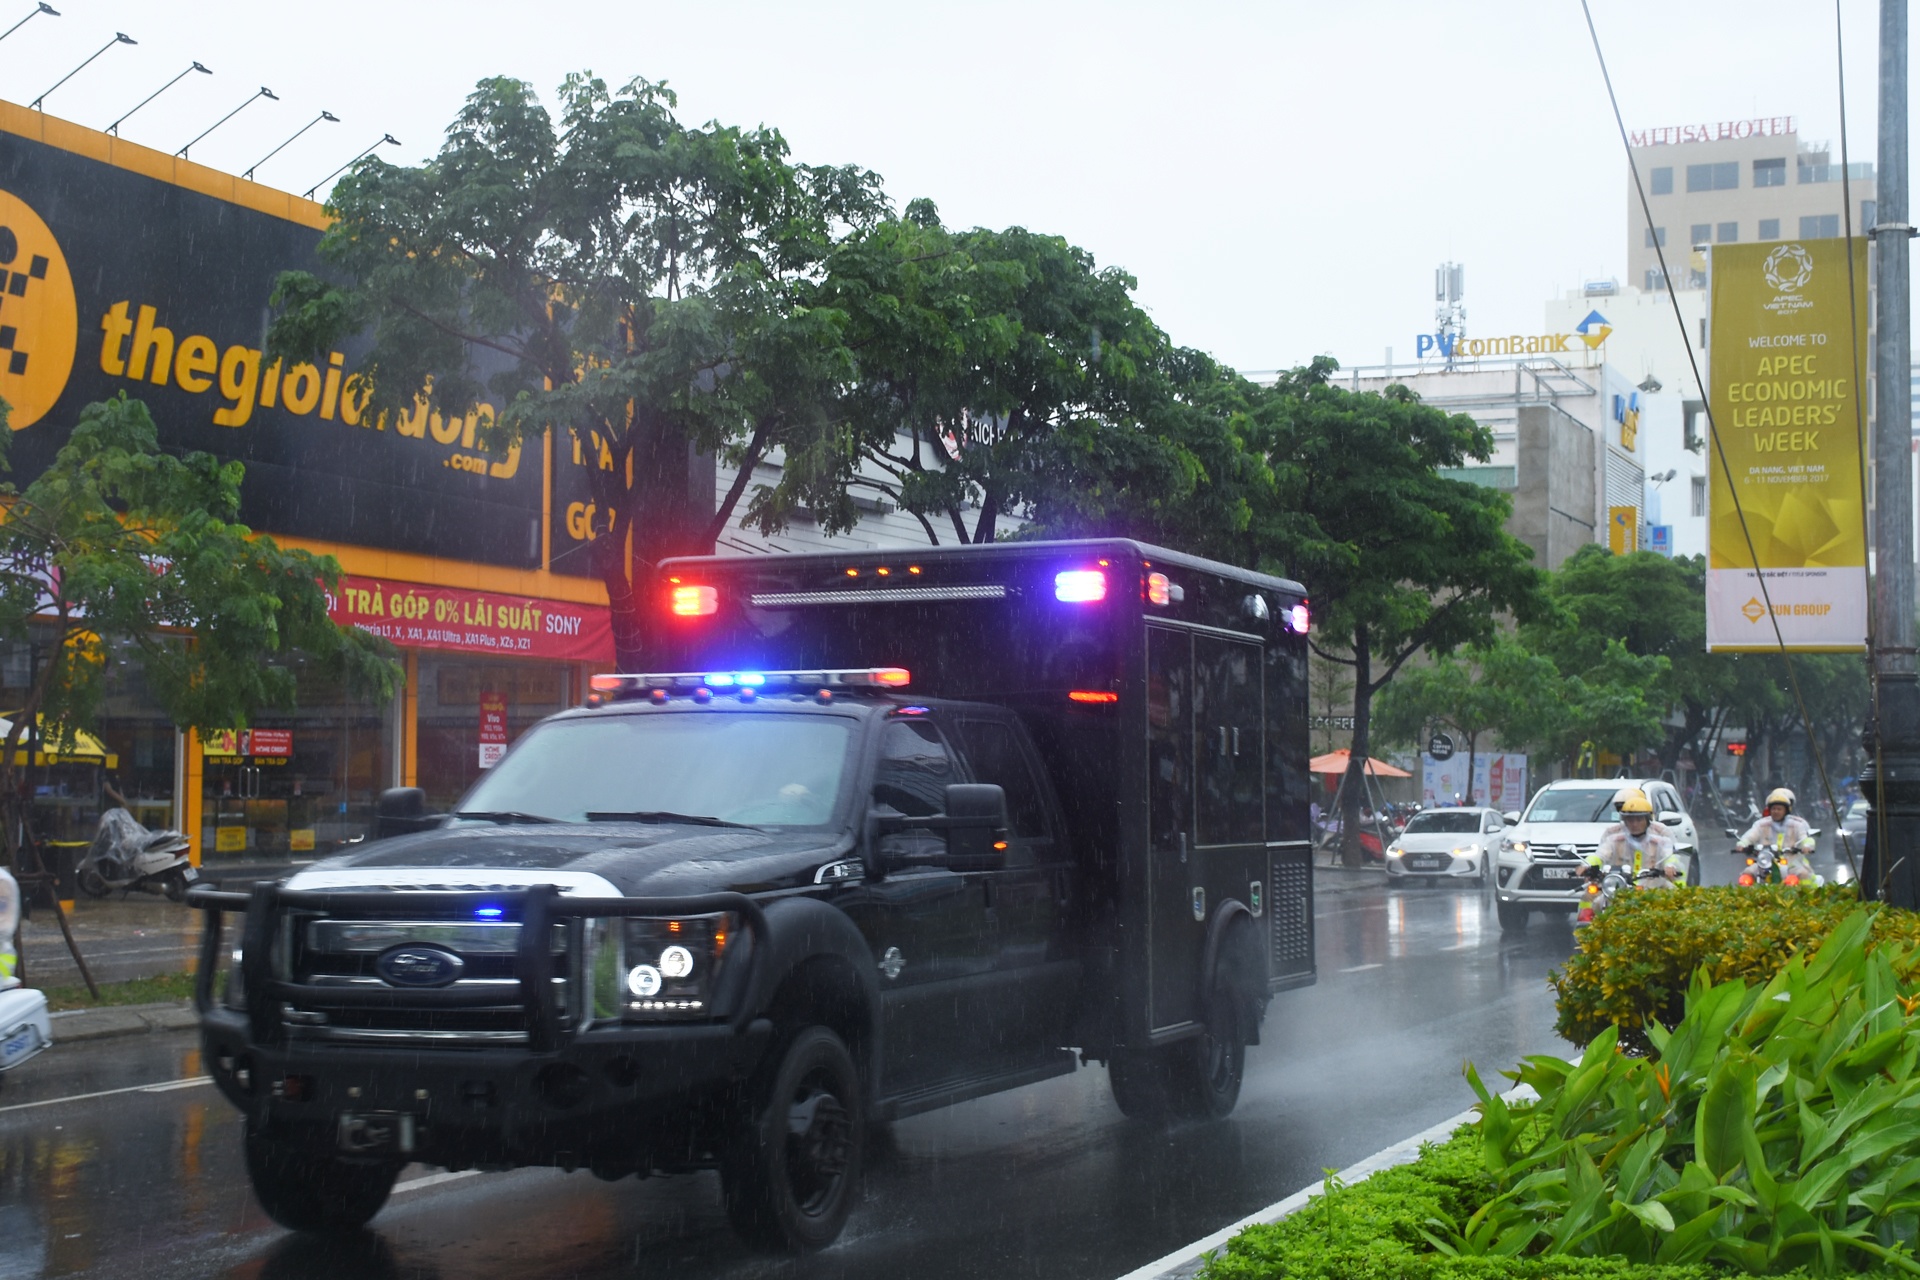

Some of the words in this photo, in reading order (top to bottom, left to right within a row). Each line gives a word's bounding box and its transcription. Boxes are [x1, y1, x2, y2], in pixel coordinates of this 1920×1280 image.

[1630, 124, 1710, 148] MITISA
[1717, 116, 1797, 140] HOTEL
[1763, 302, 1787, 310] VIET
[1788, 301, 1813, 309] NAM
[1773, 294, 1803, 303] APEC
[1748, 334, 1806, 348] WELCOME
[1810, 333, 1827, 346] TO
[1757, 355, 1817, 376] APEC
[1728, 379, 1847, 403] ECONOMIC
[1754, 431, 1819, 453] WEEK
[443, 453, 488, 475] .com
[1749, 467, 1760, 475] DA
[1788, 465, 1805, 473] VIET
[1807, 464, 1825, 473] NAM
[1744, 476, 1750, 484] 6
[1757, 476, 1765, 484] 11
[1767, 475, 1808, 483] NOVEMBER
[1809, 474, 1830, 482] 2017
[345, 583, 385, 617] TRẢ
[390, 589, 429, 621] GÓP
[435, 598, 459, 624] 0%
[464, 597, 492, 627] LÃI
[497, 601, 542, 632] SUẤT
[545, 613, 582, 636] SONY
[1794, 604, 1831, 616] GROUP
